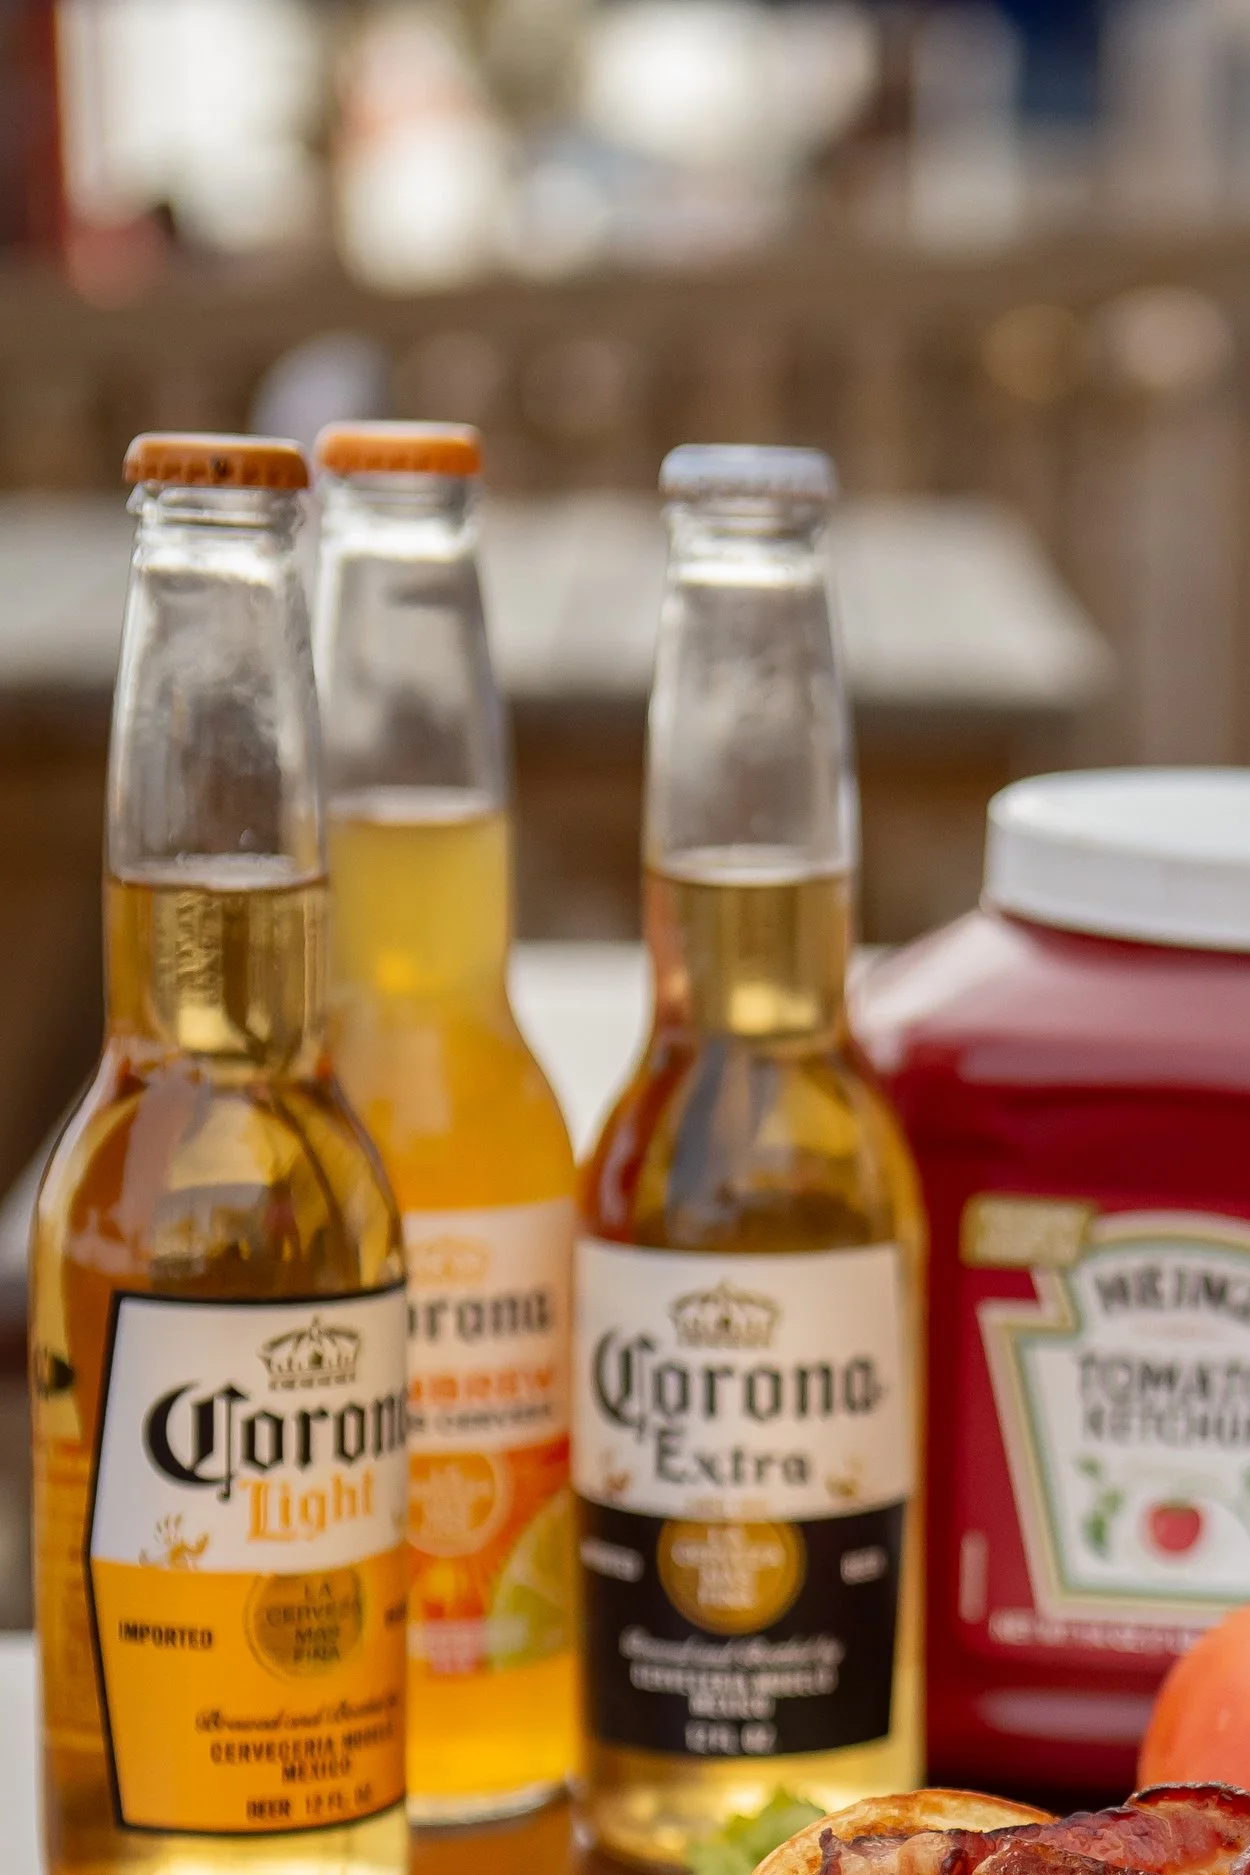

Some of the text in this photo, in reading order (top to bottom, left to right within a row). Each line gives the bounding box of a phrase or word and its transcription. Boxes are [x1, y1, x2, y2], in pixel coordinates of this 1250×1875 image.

[592, 1324, 878, 1442] Corona
[140, 1380, 407, 1503] Coron
[652, 1426, 810, 1486] Extra
[238, 1468, 376, 1544] Light
[117, 1618, 214, 1652] IMPORTED
